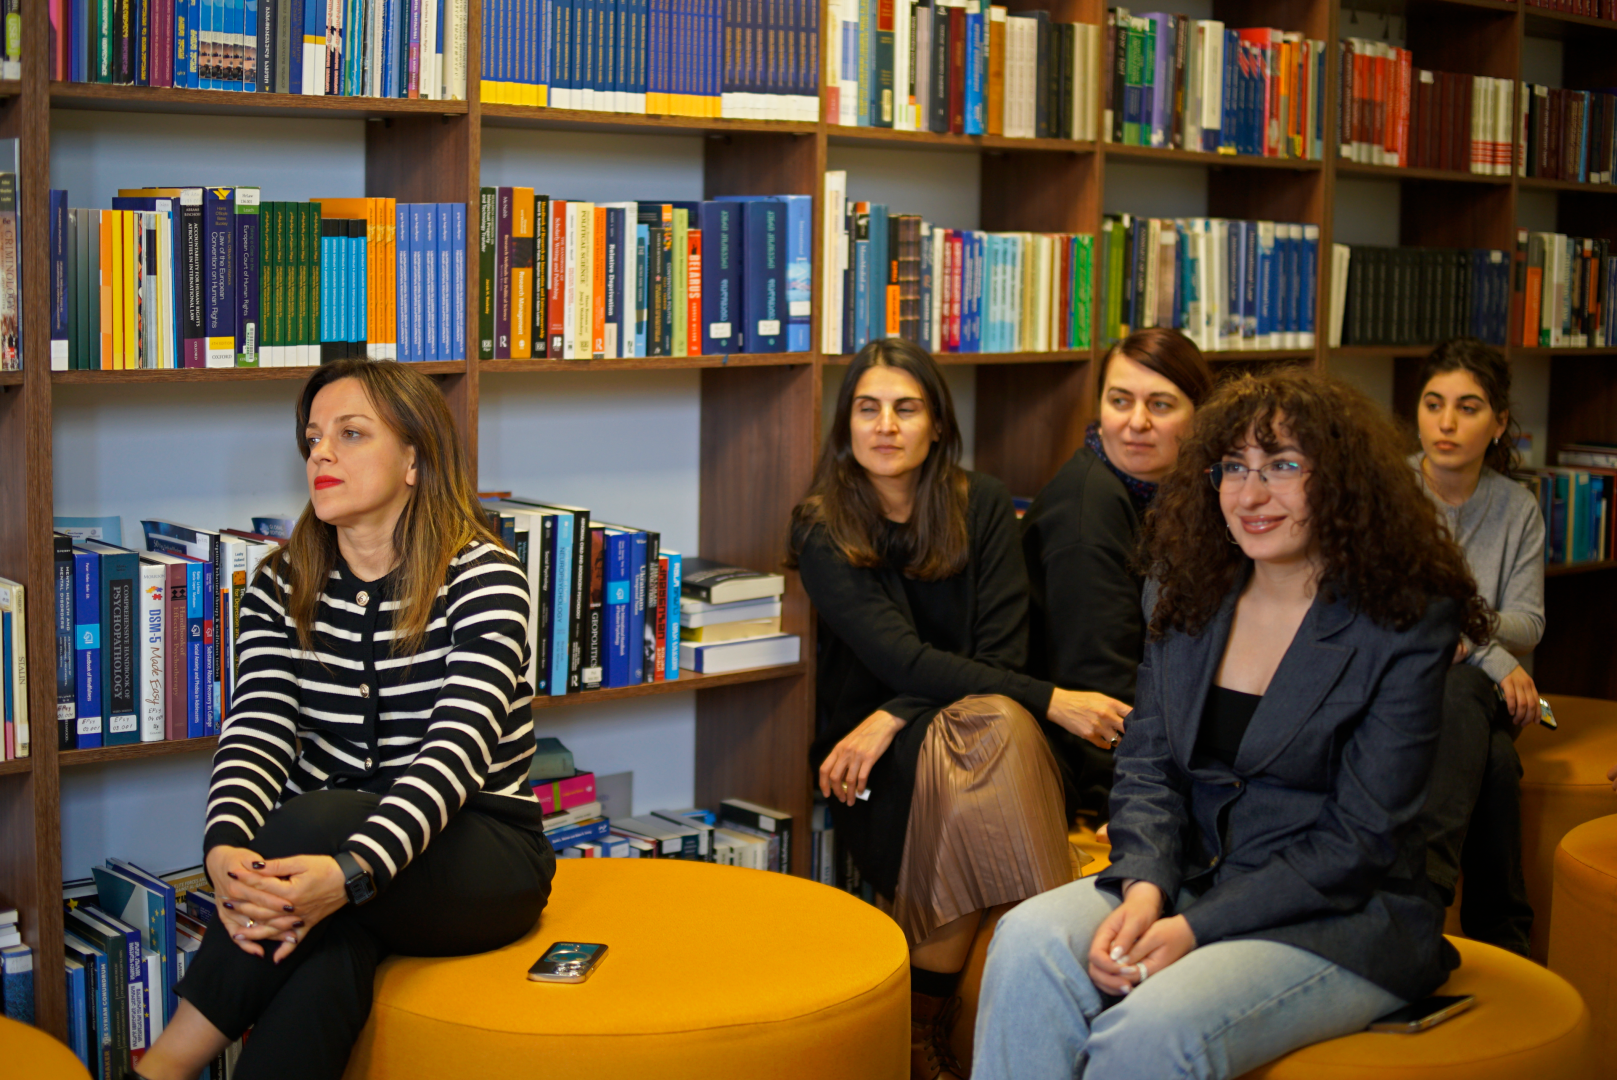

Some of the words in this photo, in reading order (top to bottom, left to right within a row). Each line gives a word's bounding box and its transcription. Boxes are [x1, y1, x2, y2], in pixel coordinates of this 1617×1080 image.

[212, 272, 218, 280] on
[689, 255, 700, 299] BELARUS
[557, 547, 565, 623] NEUROPSYCHOLOGY
[113, 587, 122, 700] PSYCHOPATHOLOGY
[149, 610, 161, 644] DSM-5
[591, 612, 599, 668] GEOPOLITICS
[150, 647, 162, 677] Made
[124, 689, 129, 699] OF
[145, 679, 161, 705] Easy
